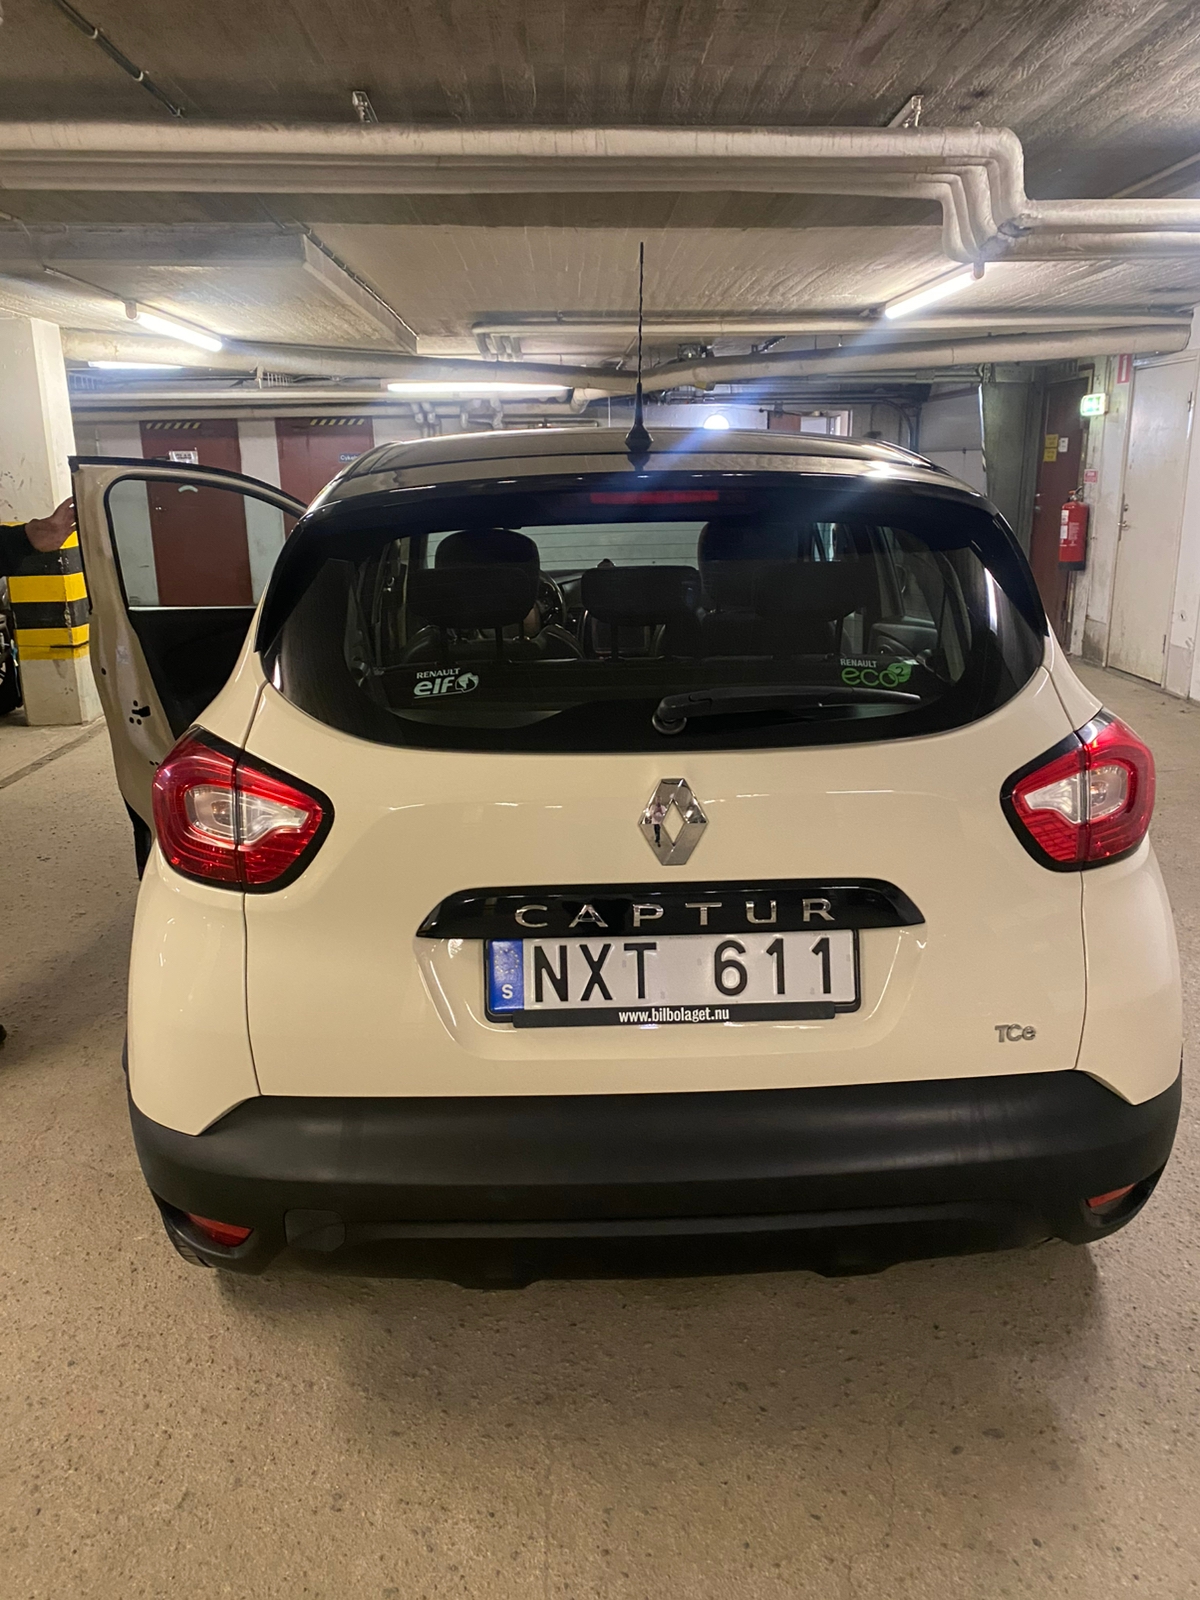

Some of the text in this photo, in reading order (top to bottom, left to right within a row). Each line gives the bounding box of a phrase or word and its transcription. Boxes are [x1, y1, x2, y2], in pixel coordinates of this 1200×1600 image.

[840, 658, 877, 668] RENAULT
[416, 667, 461, 680] RENAULT
[413, 676, 455, 696] elf
[514, 898, 835, 928] CAPTUR
[534, 937, 832, 1003] NXT 611
[502, 984, 514, 999] S
[618, 1007, 730, 1023] www.bilbolaget.nu
[994, 1023, 1036, 1043] TCe
